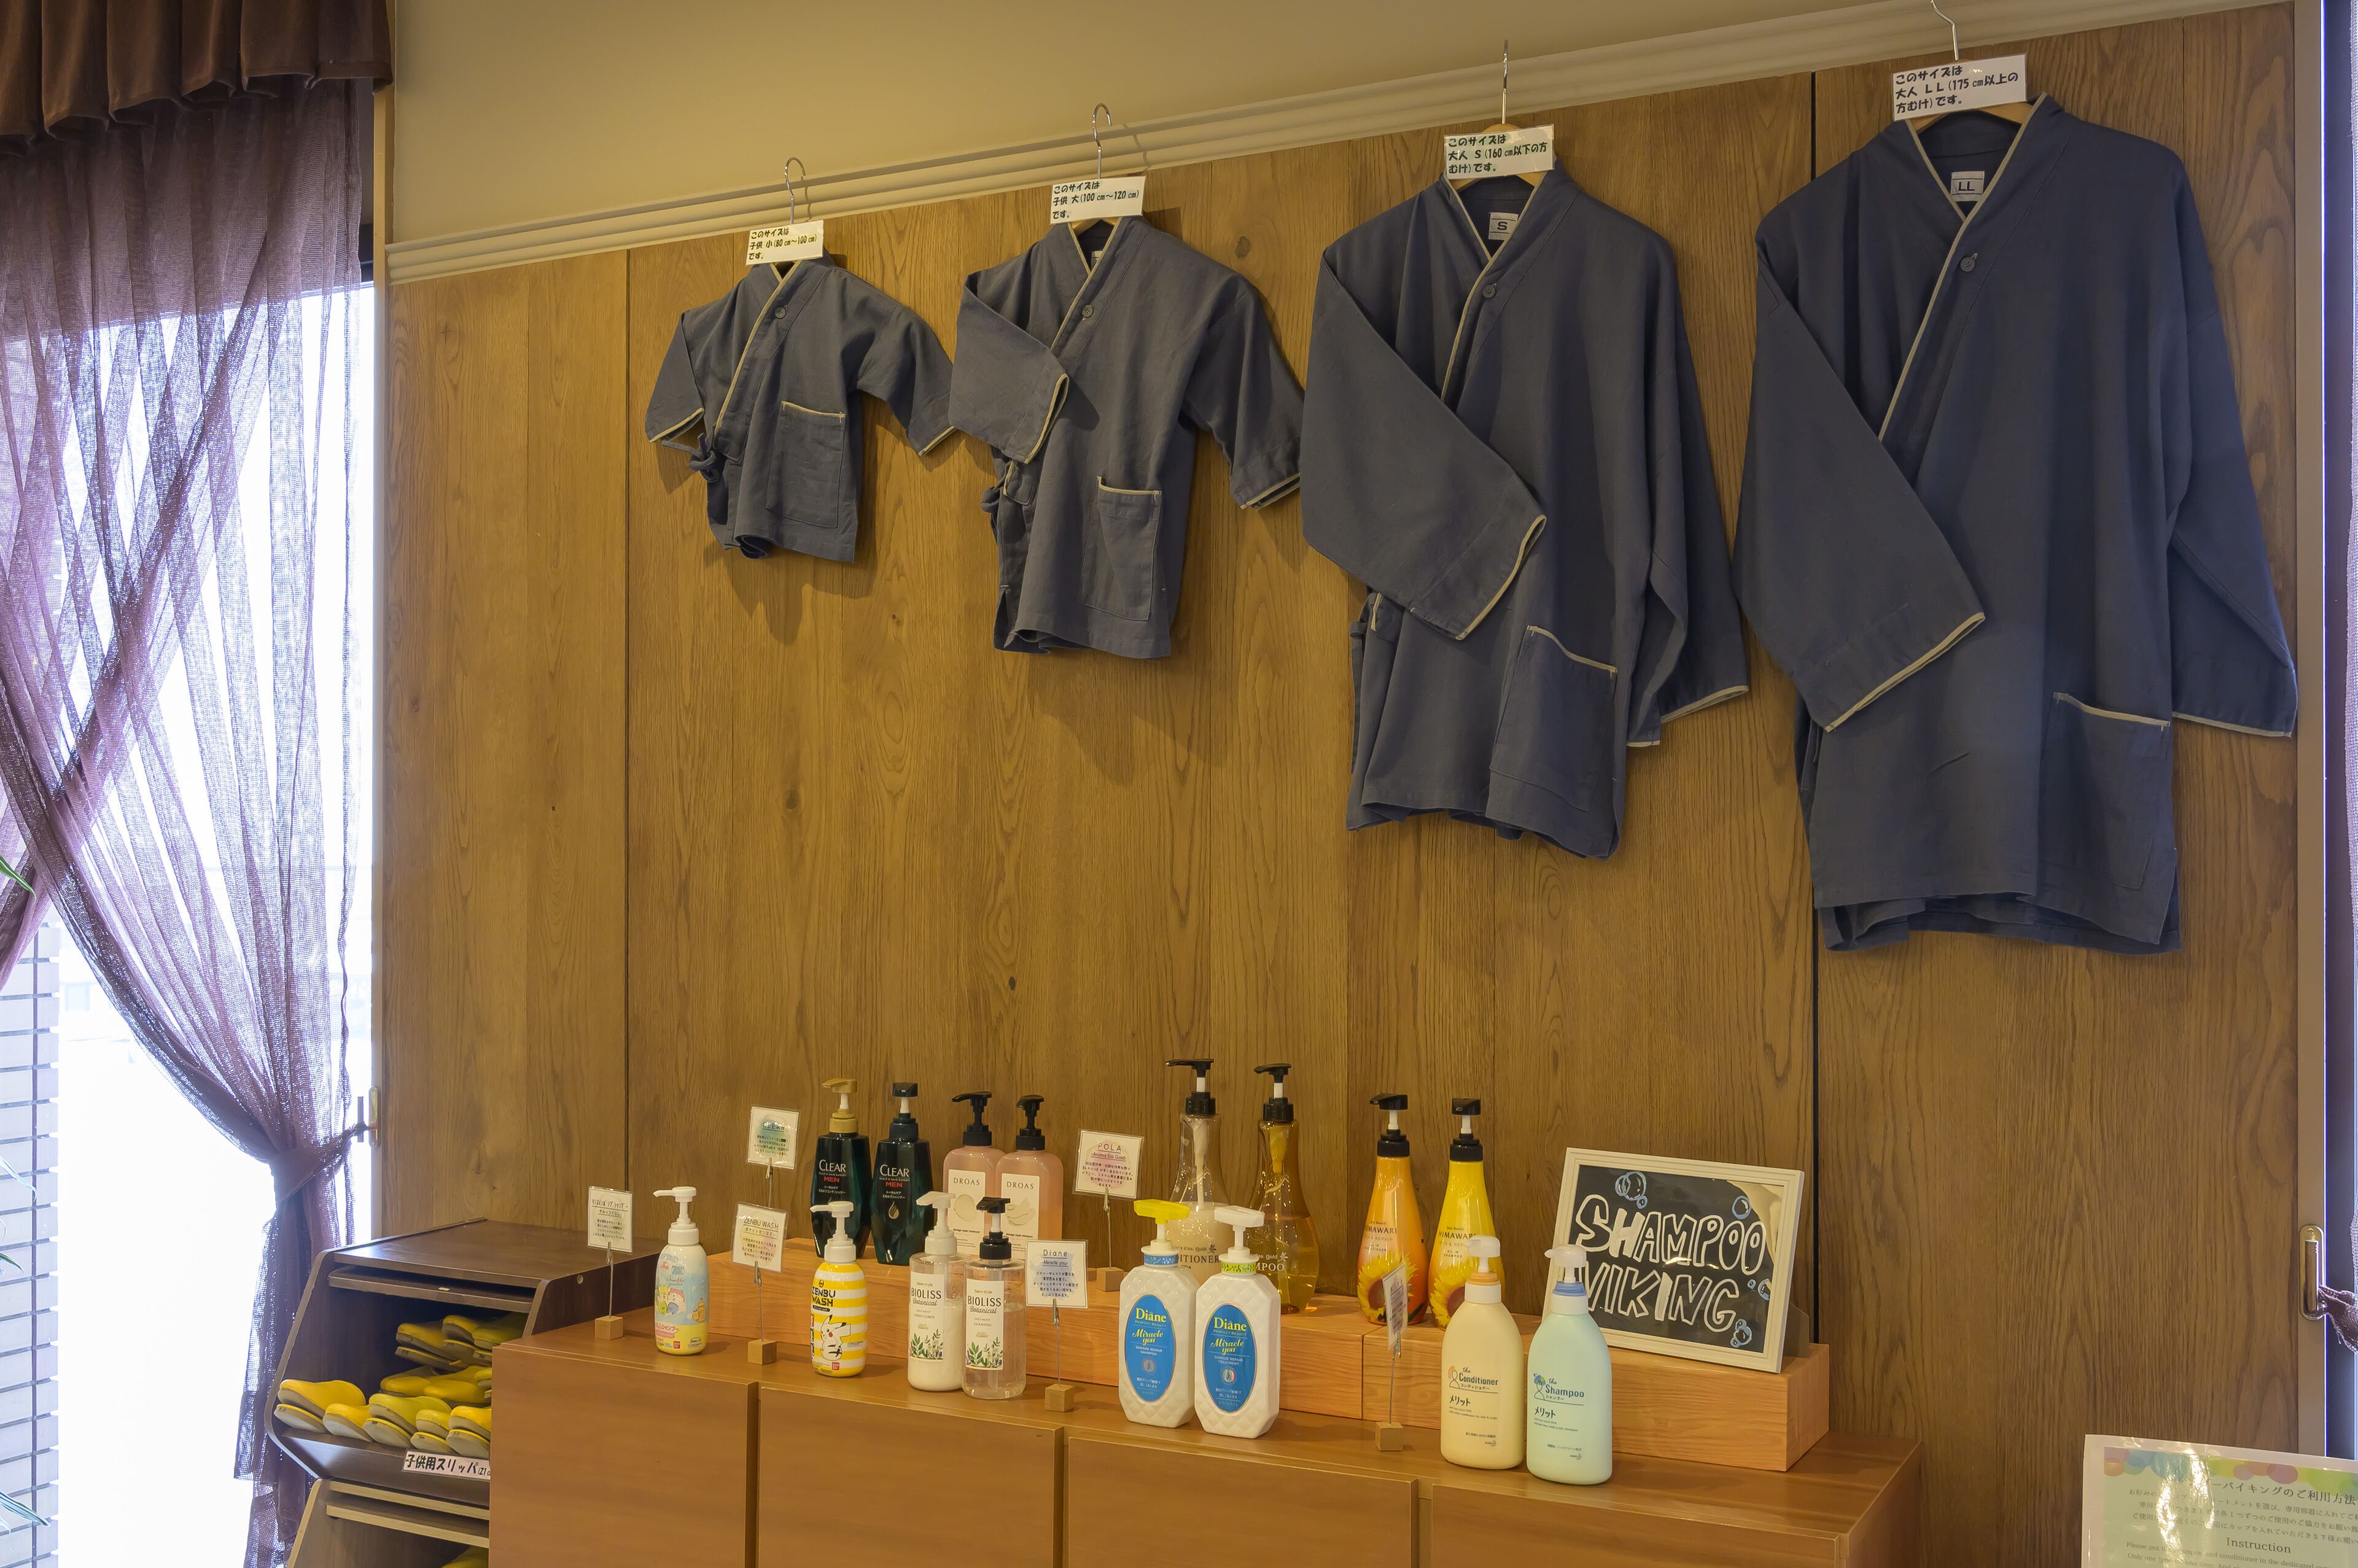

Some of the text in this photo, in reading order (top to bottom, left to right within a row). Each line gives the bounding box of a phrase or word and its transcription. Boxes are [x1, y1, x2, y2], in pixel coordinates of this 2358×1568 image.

[1896, 66, 1963, 85] このサイズは
[1896, 87, 1918, 99] 大人
[1896, 95, 1962, 114] 方むけ)です。
[1449, 134, 1506, 147] このサイズは
[1449, 163, 1496, 174] むけ)です。
[1054, 182, 1100, 194] このサイズは
[1958, 182, 1975, 191] LL
[1053, 196, 1067, 206] 子供
[1053, 210, 1070, 219] です。
[1497, 222, 1508, 230] S
[751, 227, 789, 239] このサイズは
[1098, 1143, 1121, 1151] POLA
[819, 1159, 846, 1173] CLEAR
[880, 1165, 909, 1177] CLEAR
[744, 1218, 779, 1230] ZENBU WASH
[1439, 1231, 1476, 1240] HIMAWAR
[1575, 1195, 1766, 1275] SHAMPOO
[1256, 1263, 1285, 1271] MPOO
[812, 1286, 836, 1298] ZENBU
[911, 1287, 941, 1299] BIOLISS
[1578, 1259, 1740, 1332] VIKING
[812, 1295, 833, 1306] WASH
[968, 1295, 1002, 1306] BIOLISS
[1135, 1308, 1167, 1322] Diâne
[1213, 1317, 1247, 1332] Diâne
[1132, 1329, 1164, 1337] Miracle
[1210, 1338, 1244, 1347] Miracle
[1222, 1347, 1235, 1356] you
[1459, 1372, 1498, 1386] Conditioner
[1546, 1384, 1584, 1398] Shampoo
[1449, 1395, 1471, 1407] メリット
[1535, 1407, 1556, 1419] メリット
[2226, 1537, 2291, 1553] Instruction
[2128, 1553, 2142, 1561] Only
[2219, 1553, 2258, 1564] conditioner
